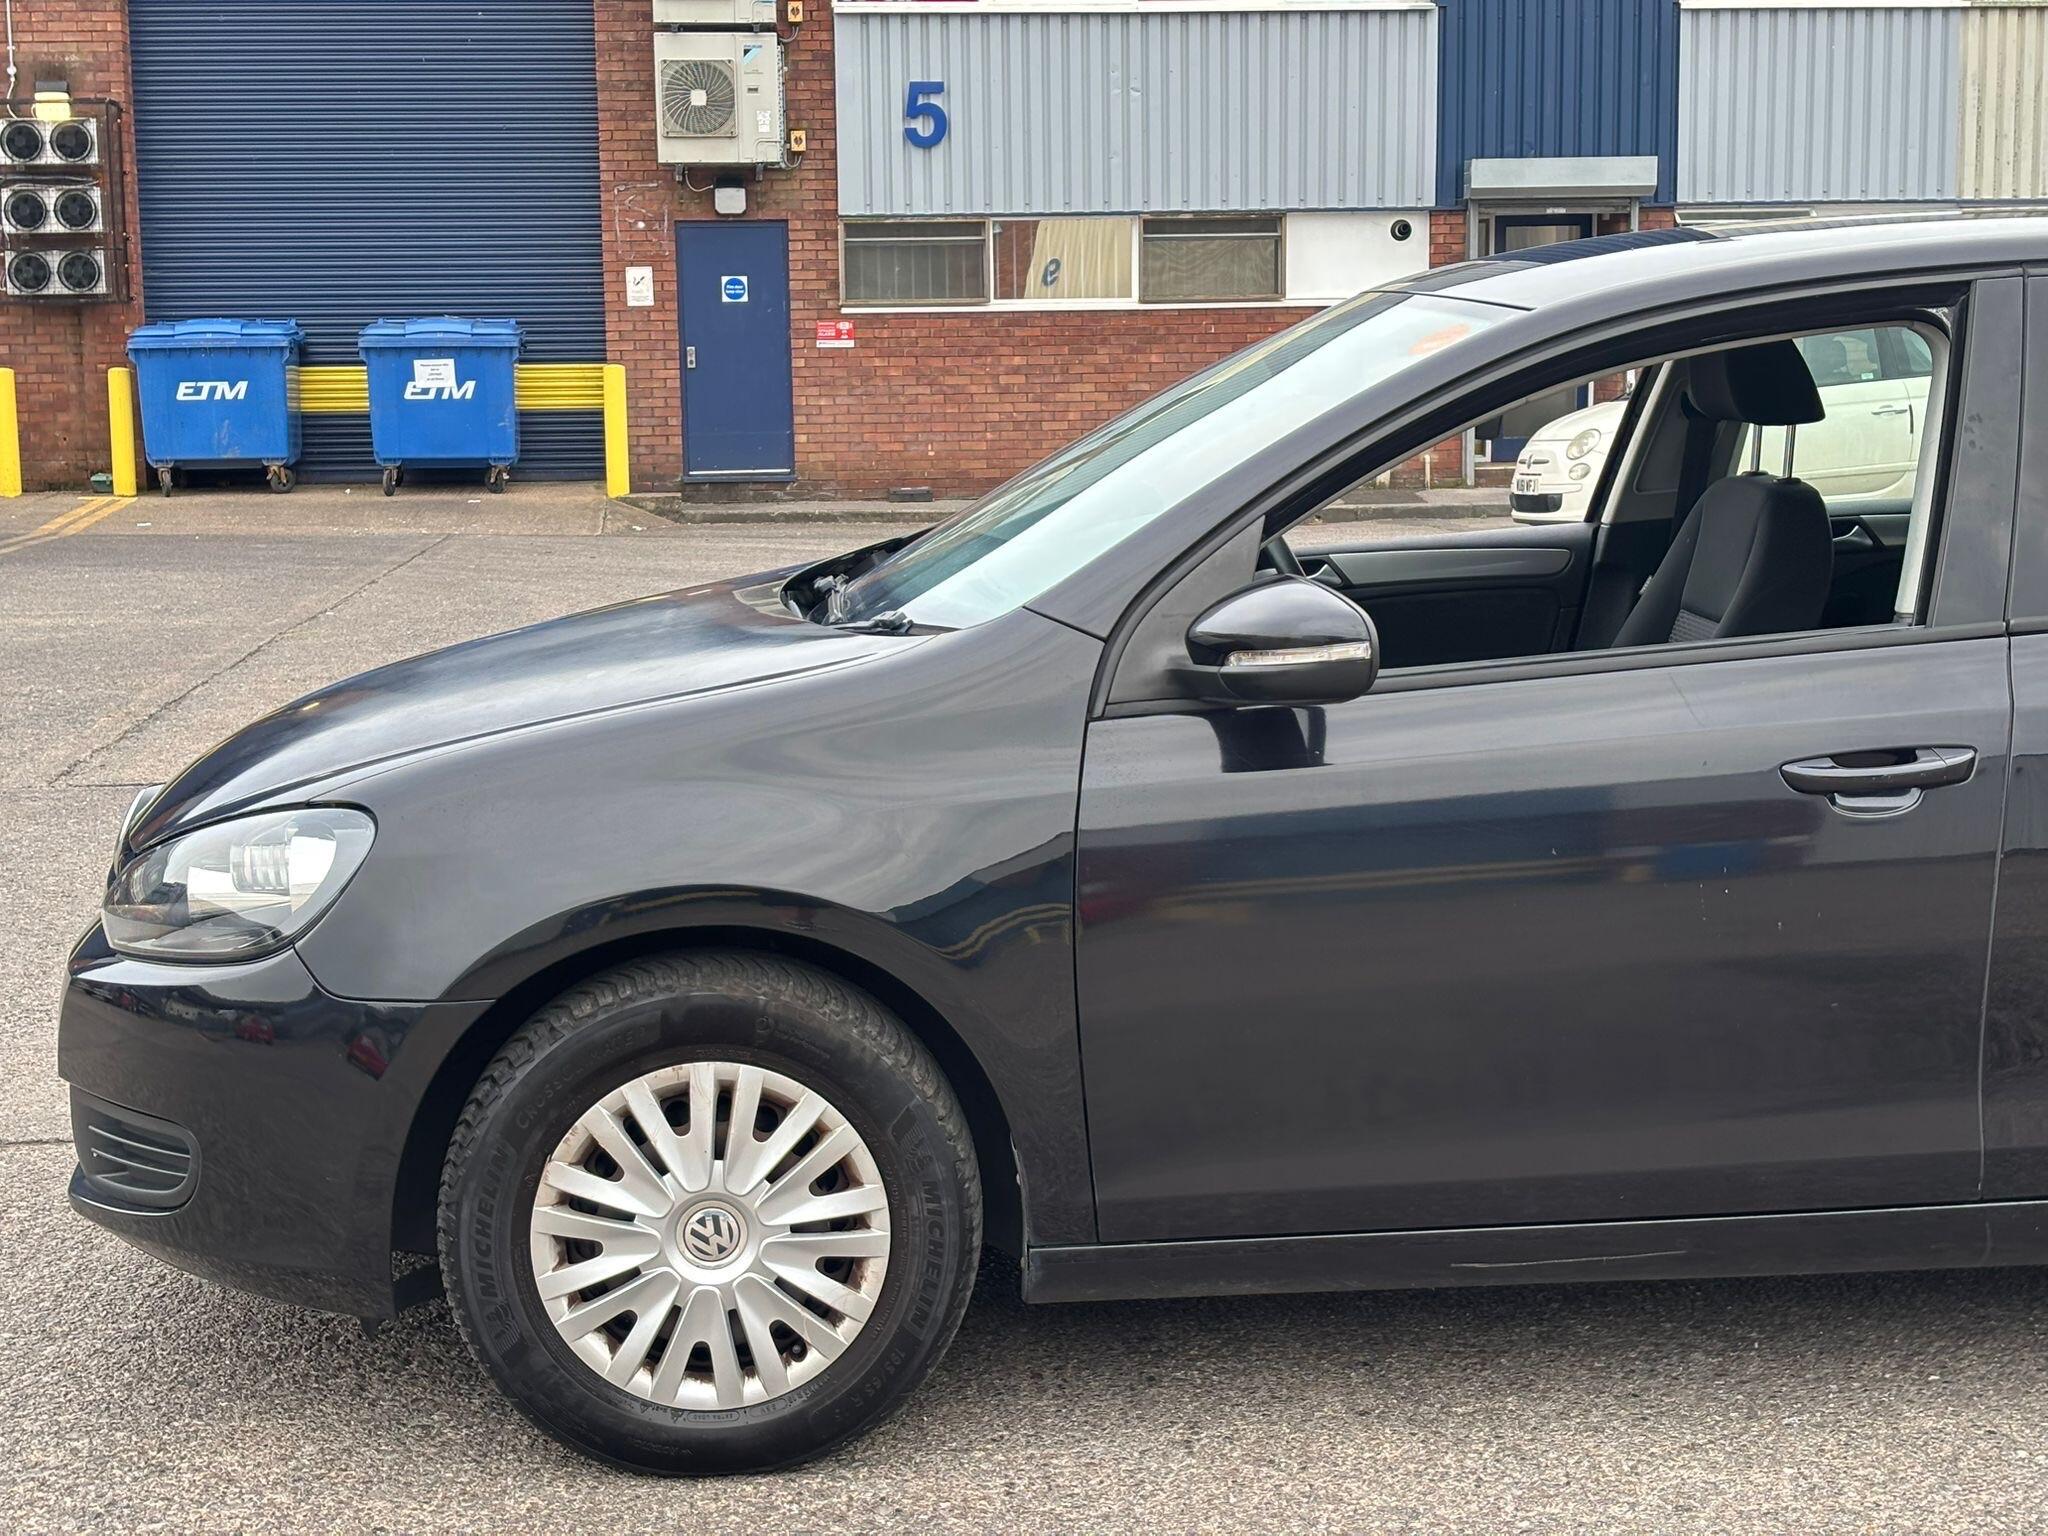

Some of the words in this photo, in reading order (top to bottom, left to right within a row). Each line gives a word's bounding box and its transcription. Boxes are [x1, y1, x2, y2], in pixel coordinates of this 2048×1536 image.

[904, 81, 947, 149] 5
[176, 380, 249, 401] ETM
[474, 1146, 511, 1299] MICHELIN
[909, 1180, 945, 1330] MICHELIN
